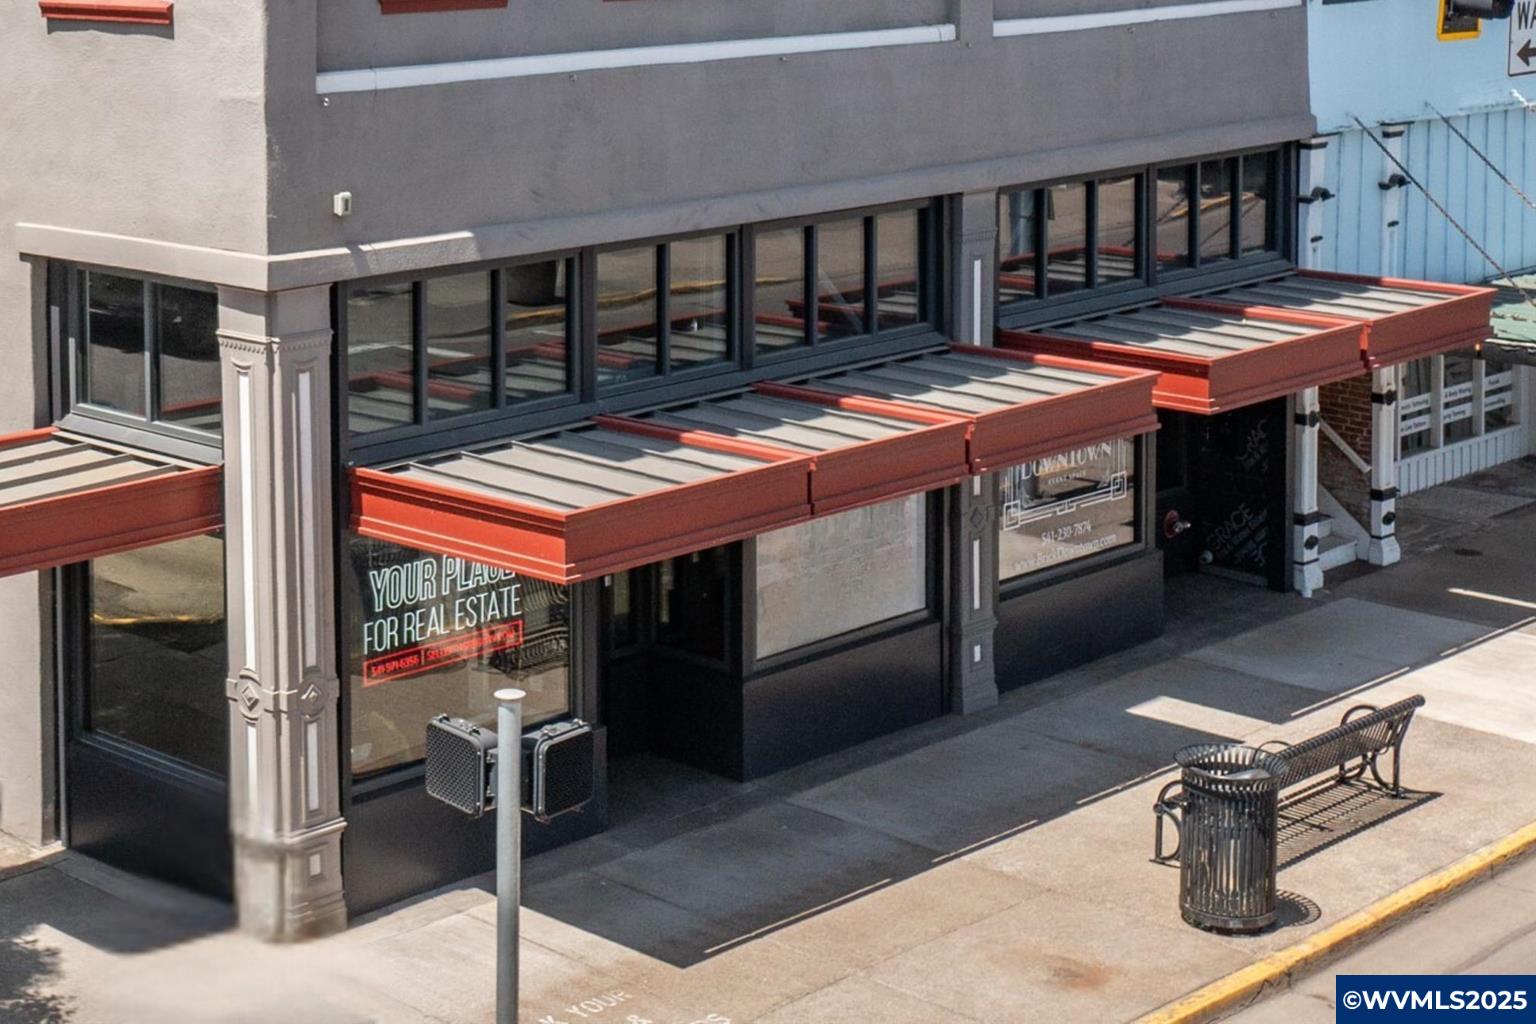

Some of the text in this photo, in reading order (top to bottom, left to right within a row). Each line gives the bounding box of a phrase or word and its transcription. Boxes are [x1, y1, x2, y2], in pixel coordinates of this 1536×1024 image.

[369, 558, 437, 612] YOUR
[364, 616, 399, 655] FOR
[404, 603, 450, 645] REAL
[455, 584, 522, 631] ESTATE
